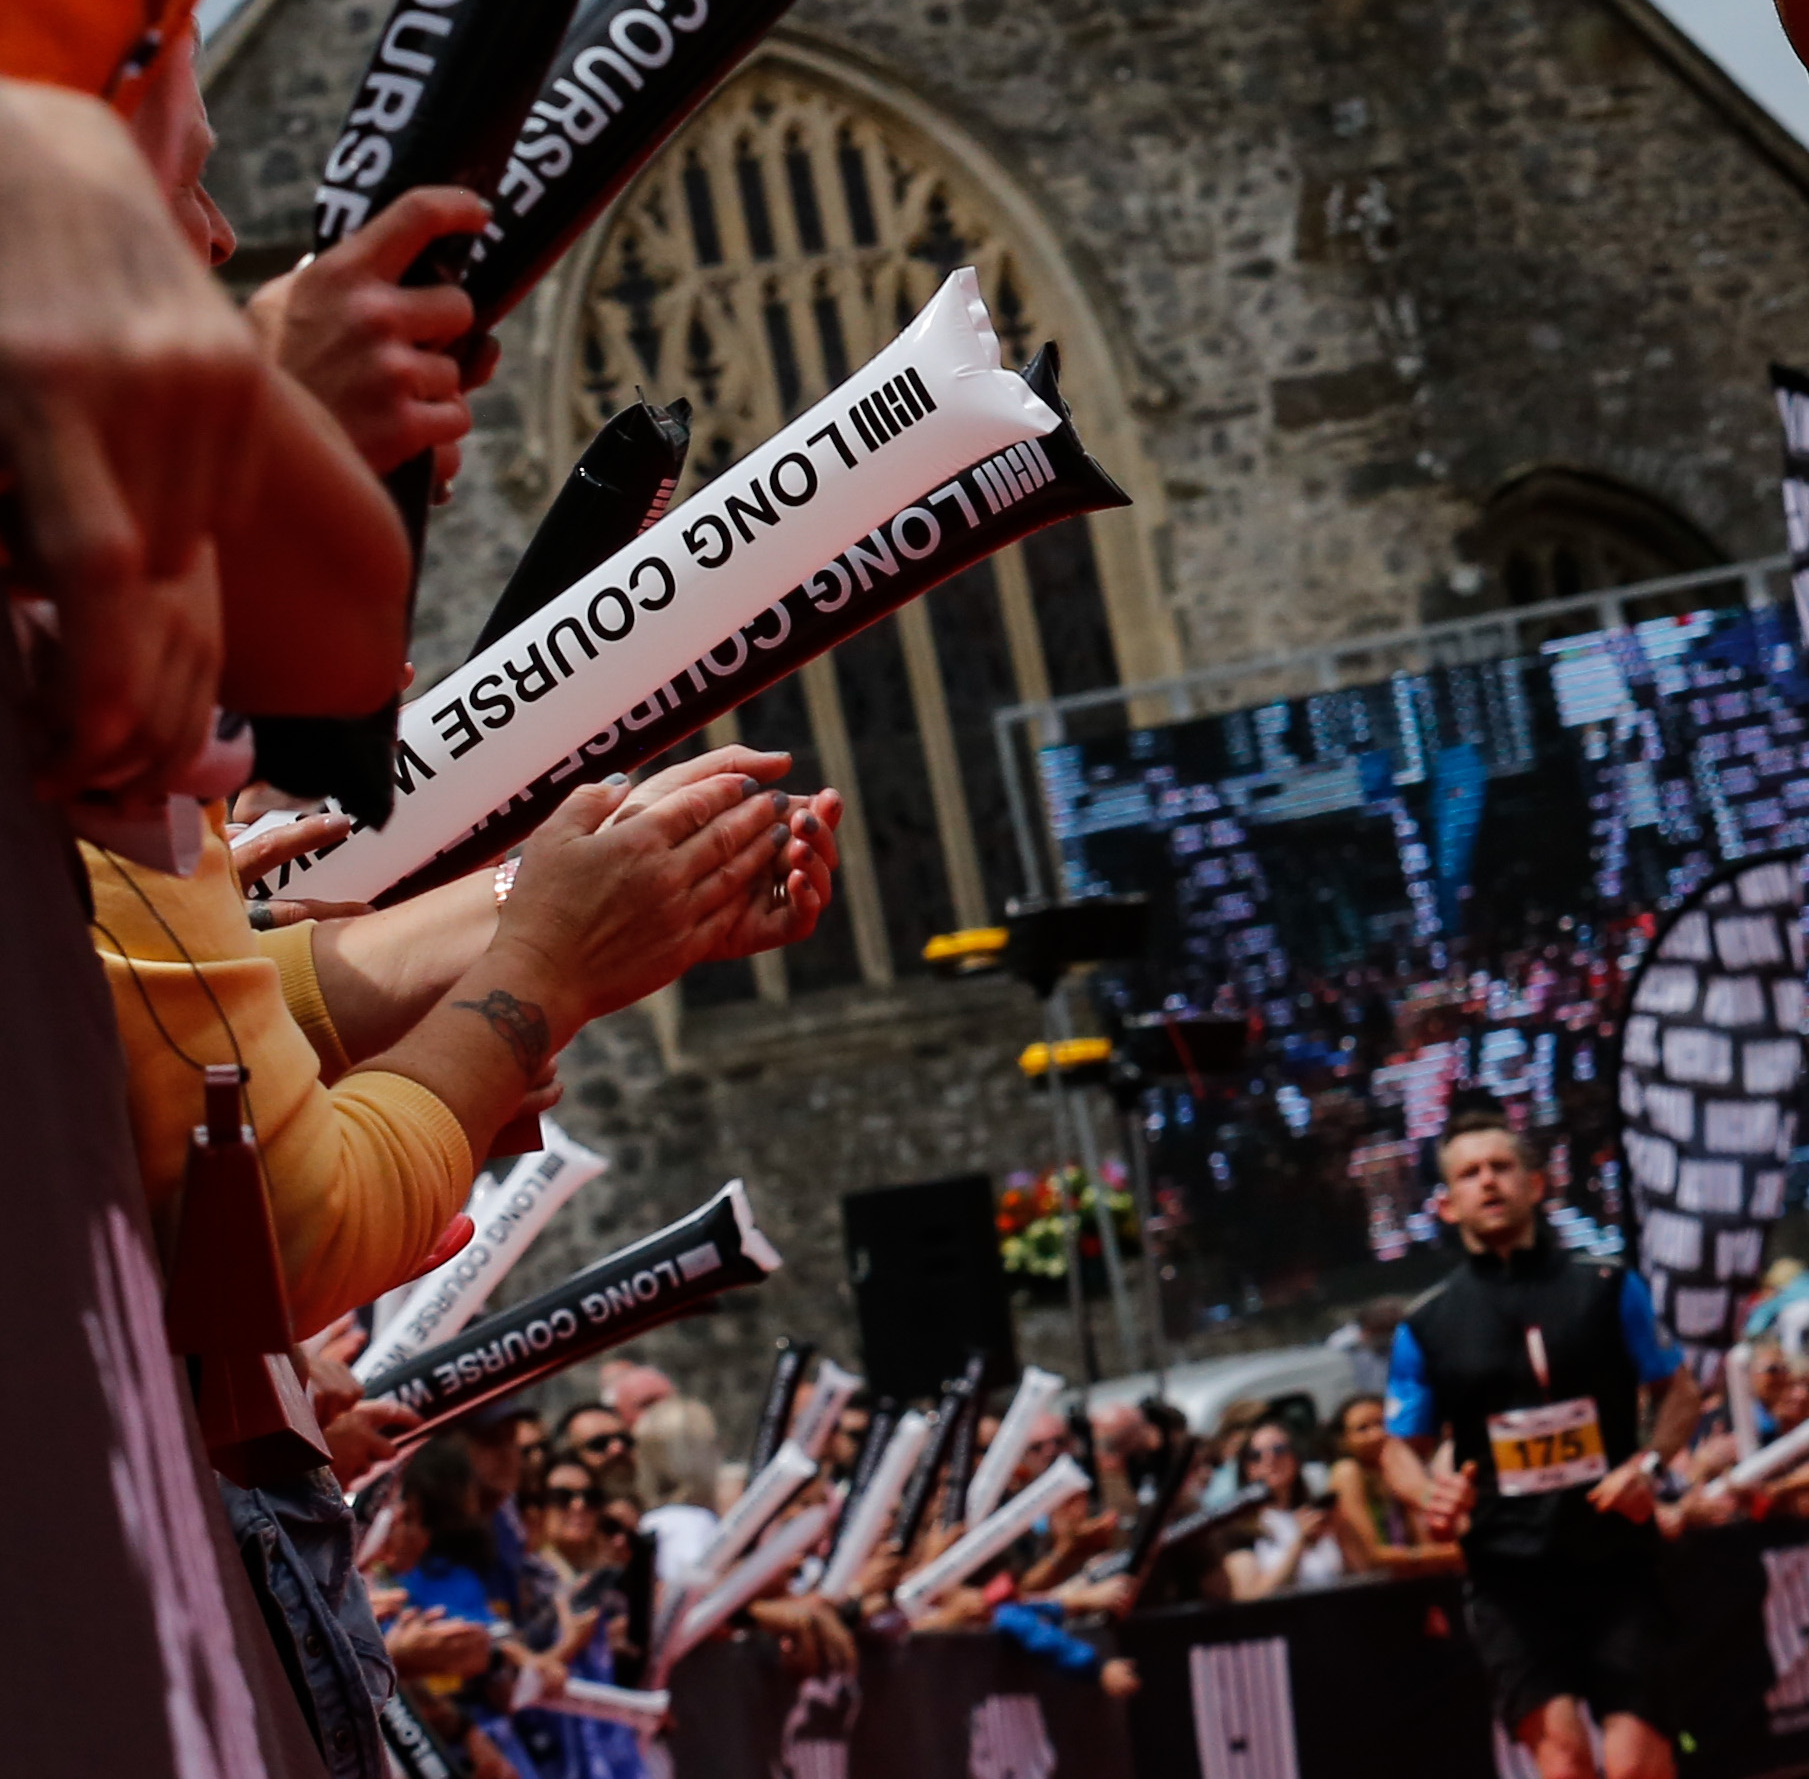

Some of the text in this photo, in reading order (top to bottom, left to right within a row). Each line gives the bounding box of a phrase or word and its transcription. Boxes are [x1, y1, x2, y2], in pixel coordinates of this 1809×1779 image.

[809, 480, 983, 616] LONG
[431, 423, 860, 763] LONG COURSE
[580, 1258, 681, 1323] LONG
[432, 1308, 579, 1395] COURSE
[1514, 1426, 1586, 1472] 175
